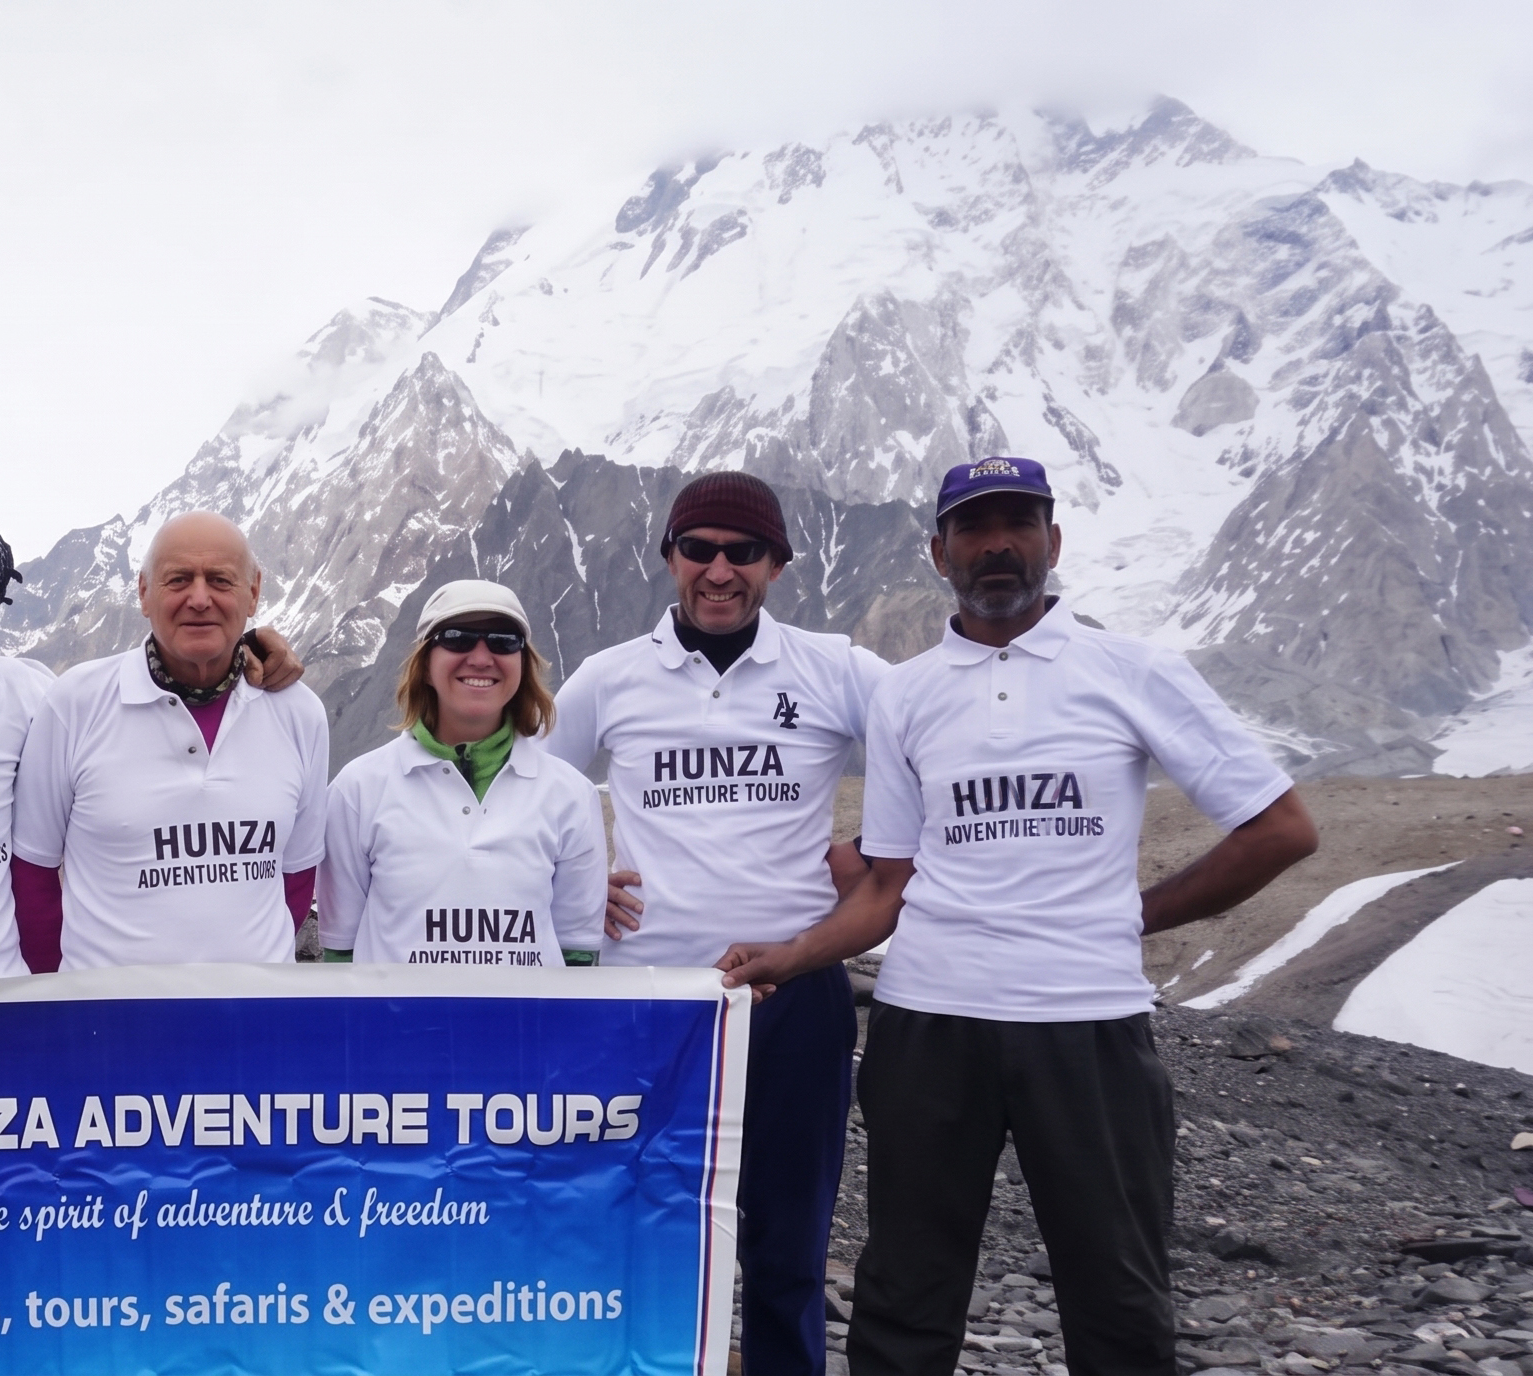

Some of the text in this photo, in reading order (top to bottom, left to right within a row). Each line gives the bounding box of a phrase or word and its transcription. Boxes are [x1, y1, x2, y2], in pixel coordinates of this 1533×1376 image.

[654, 745, 784, 782] HUNZA
[643, 782, 801, 809] ADVENTURE TOURS
[952, 771, 1083, 817] HUNZA
[153, 820, 276, 860] HUNZA
[138, 859, 276, 889] ADVENTURE TOURS
[425, 908, 536, 943] HUNZA
[74, 1093, 429, 1147] ADVENTURE
[446, 1093, 643, 1146] TOURS
[19, 1195, 105, 1242] spirit
[113, 1190, 148, 1240] of
[156, 1188, 314, 1228] adventure
[323, 1187, 350, 1226] &
[359, 1187, 491, 1238] freedom
[25, 1290, 152, 1332] tours,
[165, 1282, 310, 1326] safaris
[323, 1283, 357, 1326] &
[368, 1279, 623, 1335] expeditions
